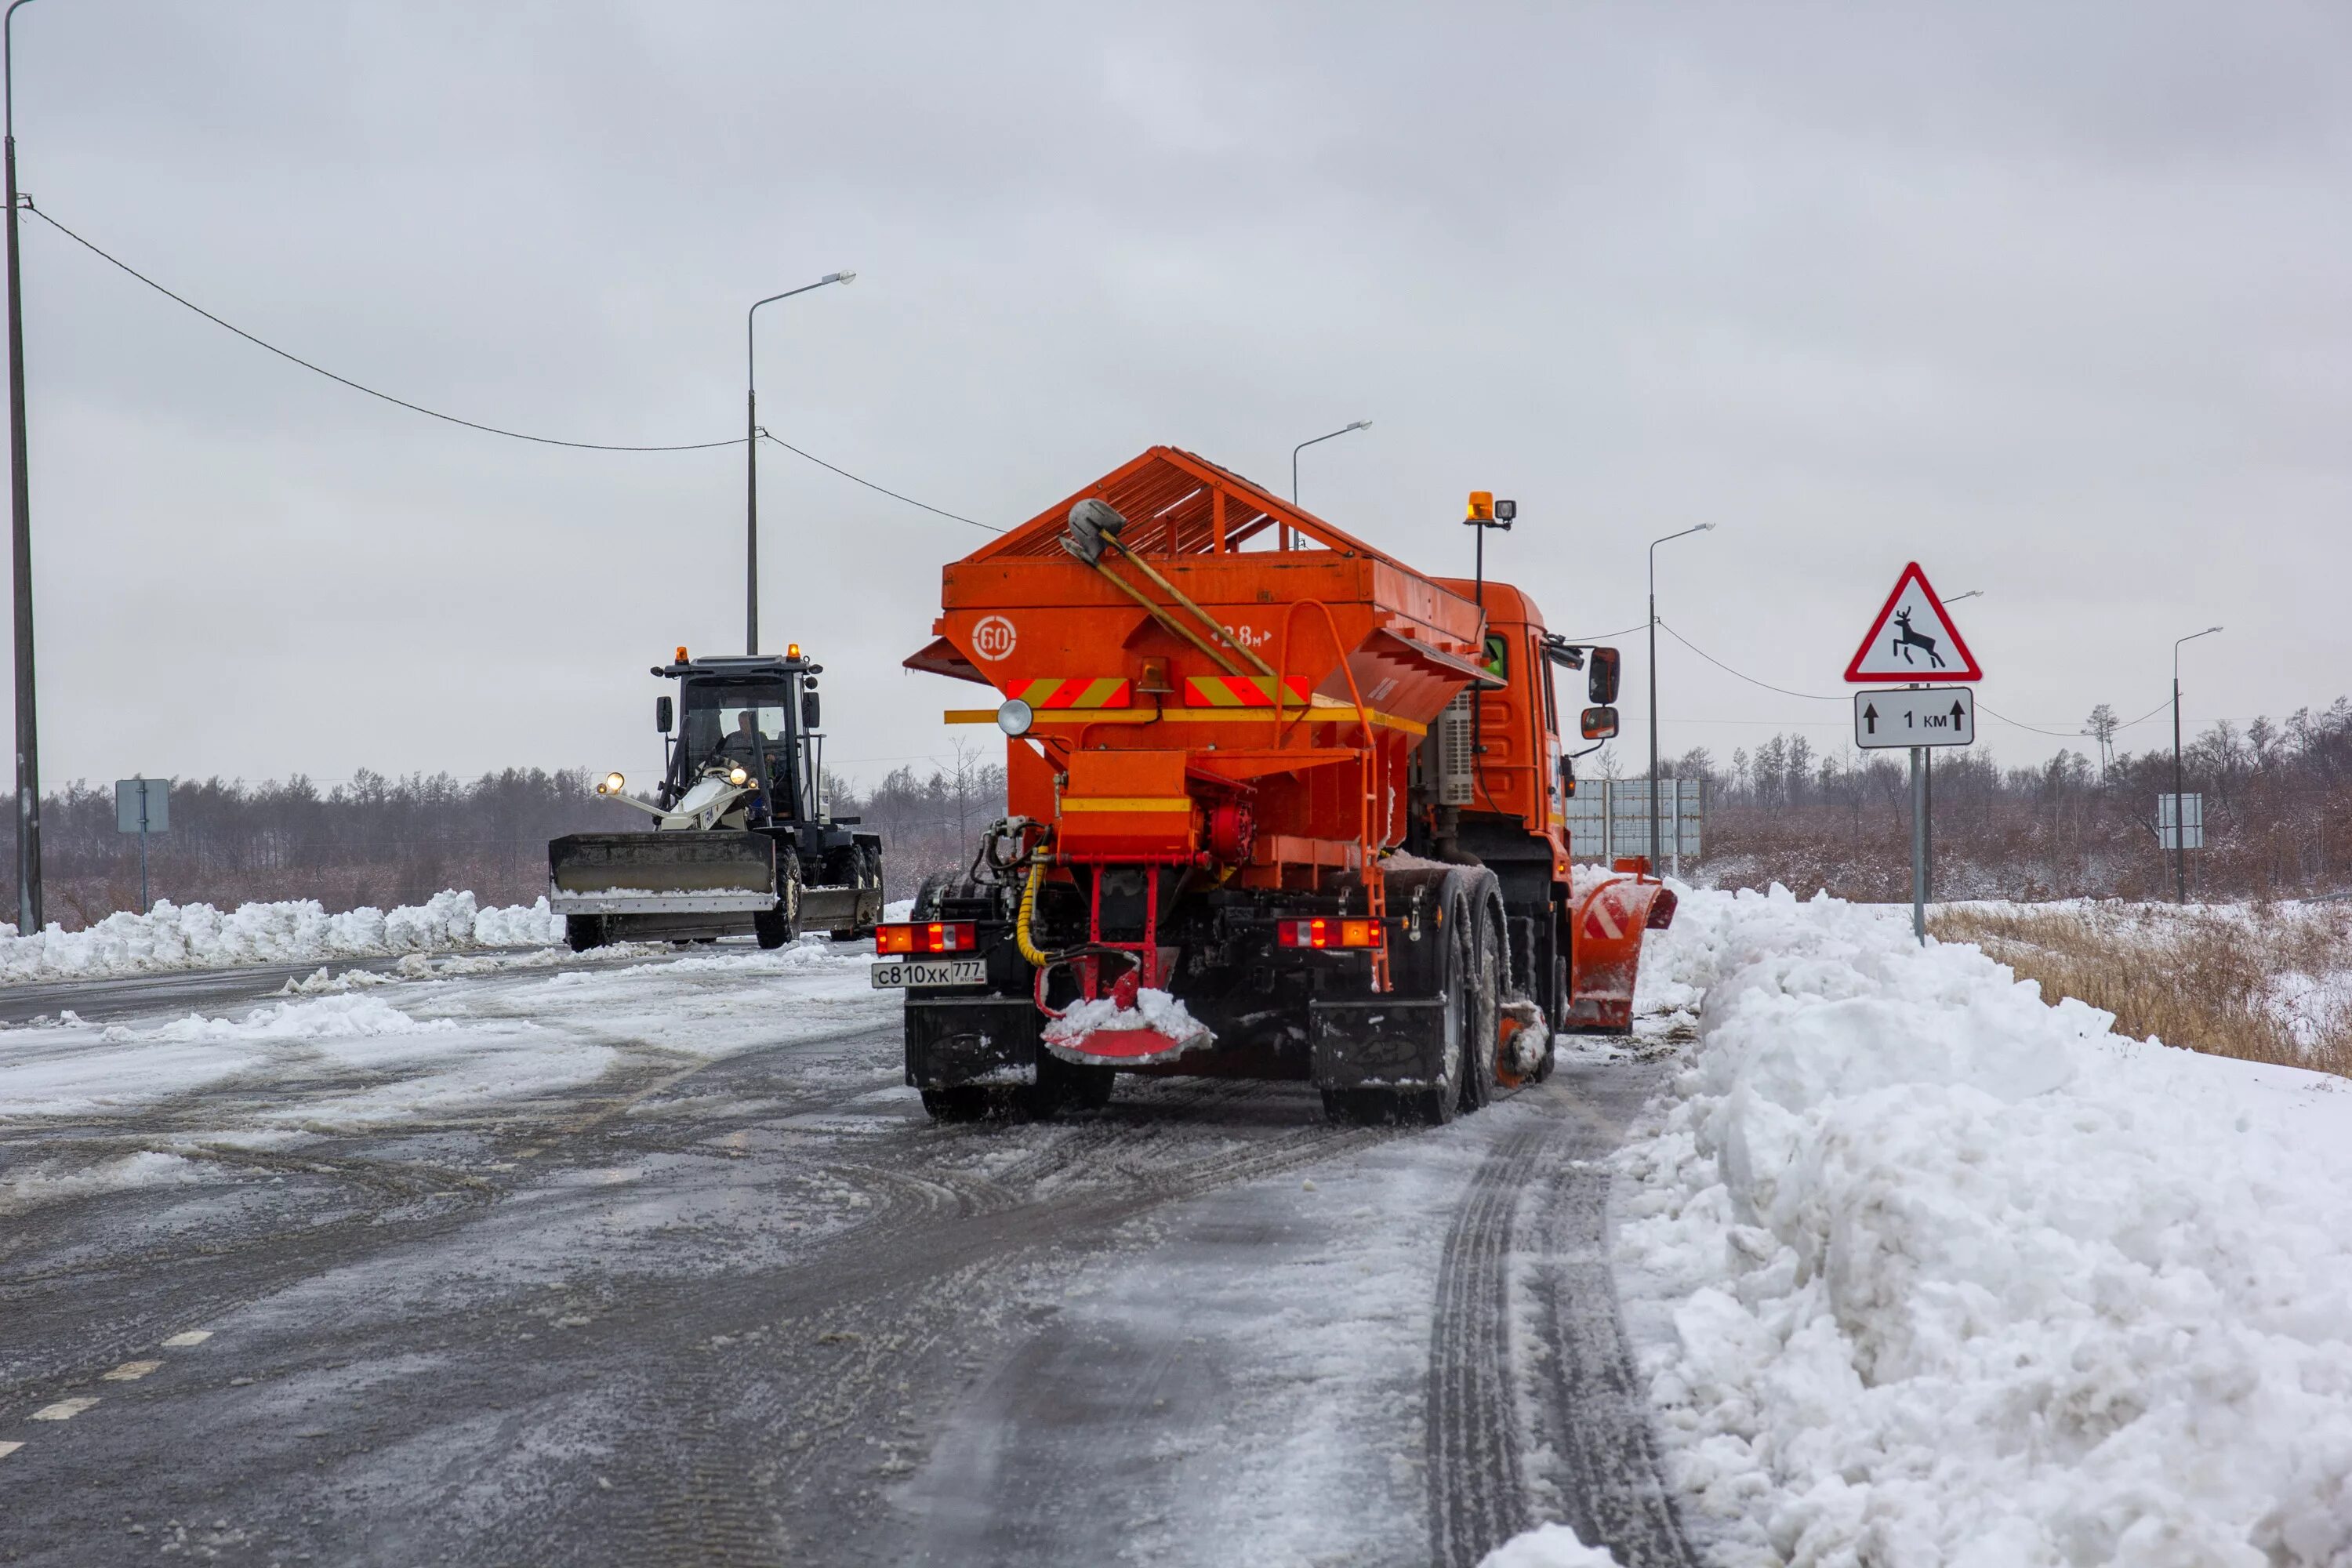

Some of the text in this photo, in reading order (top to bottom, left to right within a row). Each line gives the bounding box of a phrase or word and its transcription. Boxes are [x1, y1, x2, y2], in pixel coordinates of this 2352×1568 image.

[981, 627, 1008, 649] 60
[1904, 710, 1913, 728] 1
[953, 962, 980, 976] 777
